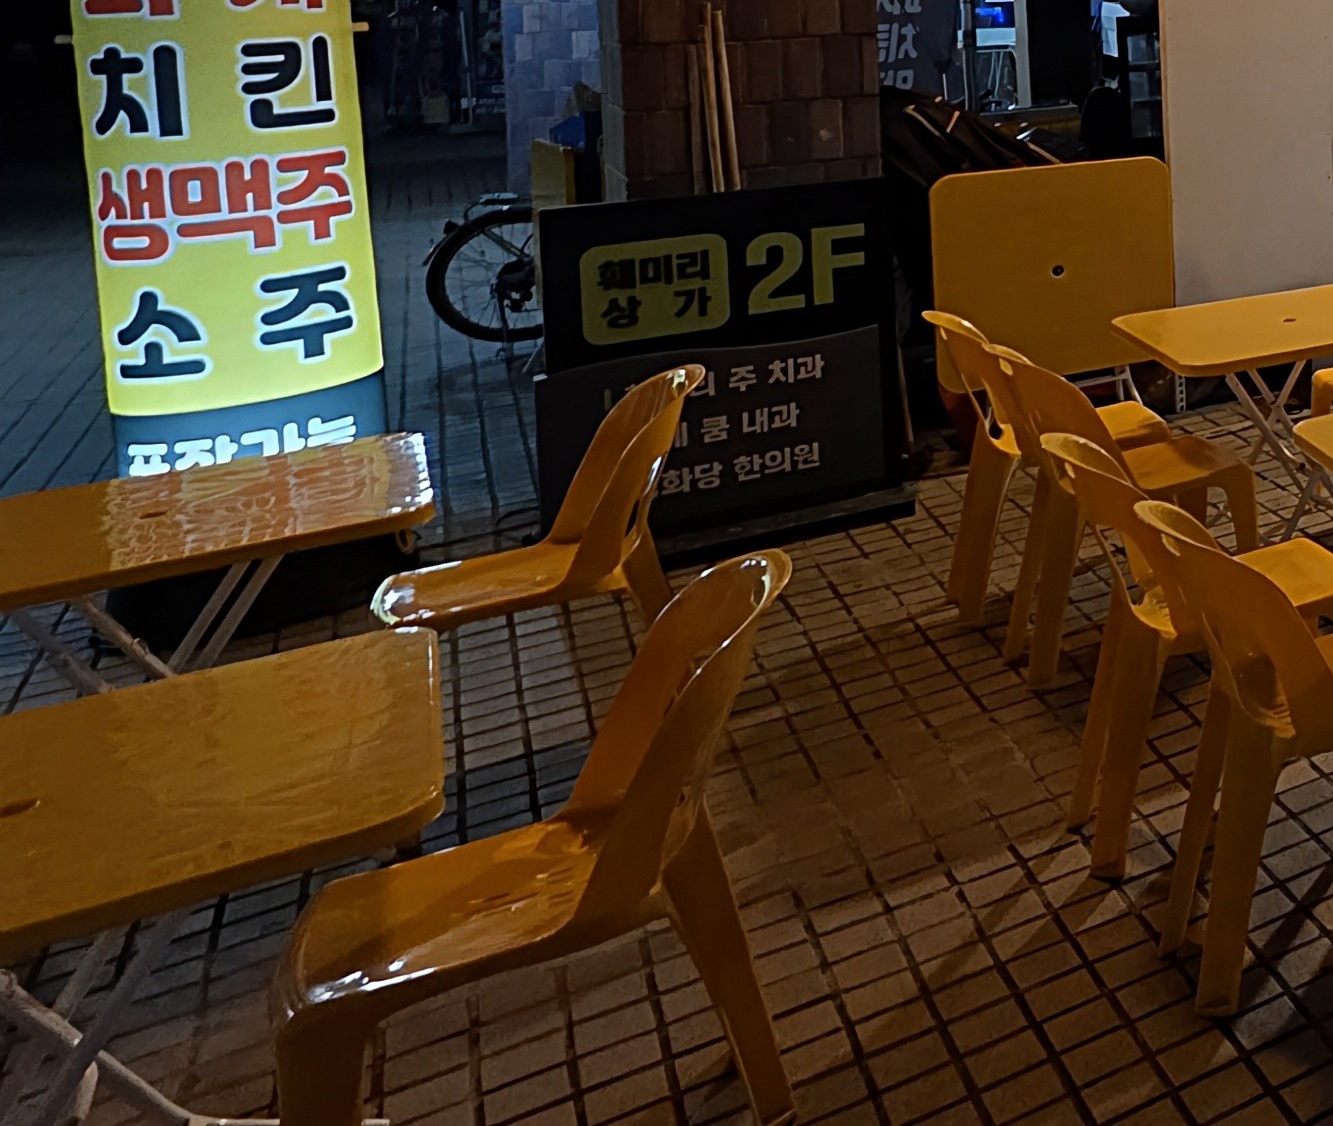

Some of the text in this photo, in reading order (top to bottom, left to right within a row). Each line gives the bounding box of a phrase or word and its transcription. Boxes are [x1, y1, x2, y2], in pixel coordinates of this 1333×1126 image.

[97, 149, 354, 262] 생맥주
[745, 223, 866, 316] 2F
[767, 353, 826, 386] 치과
[741, 401, 801, 435] 내과
[732, 441, 821, 483] 한의원
